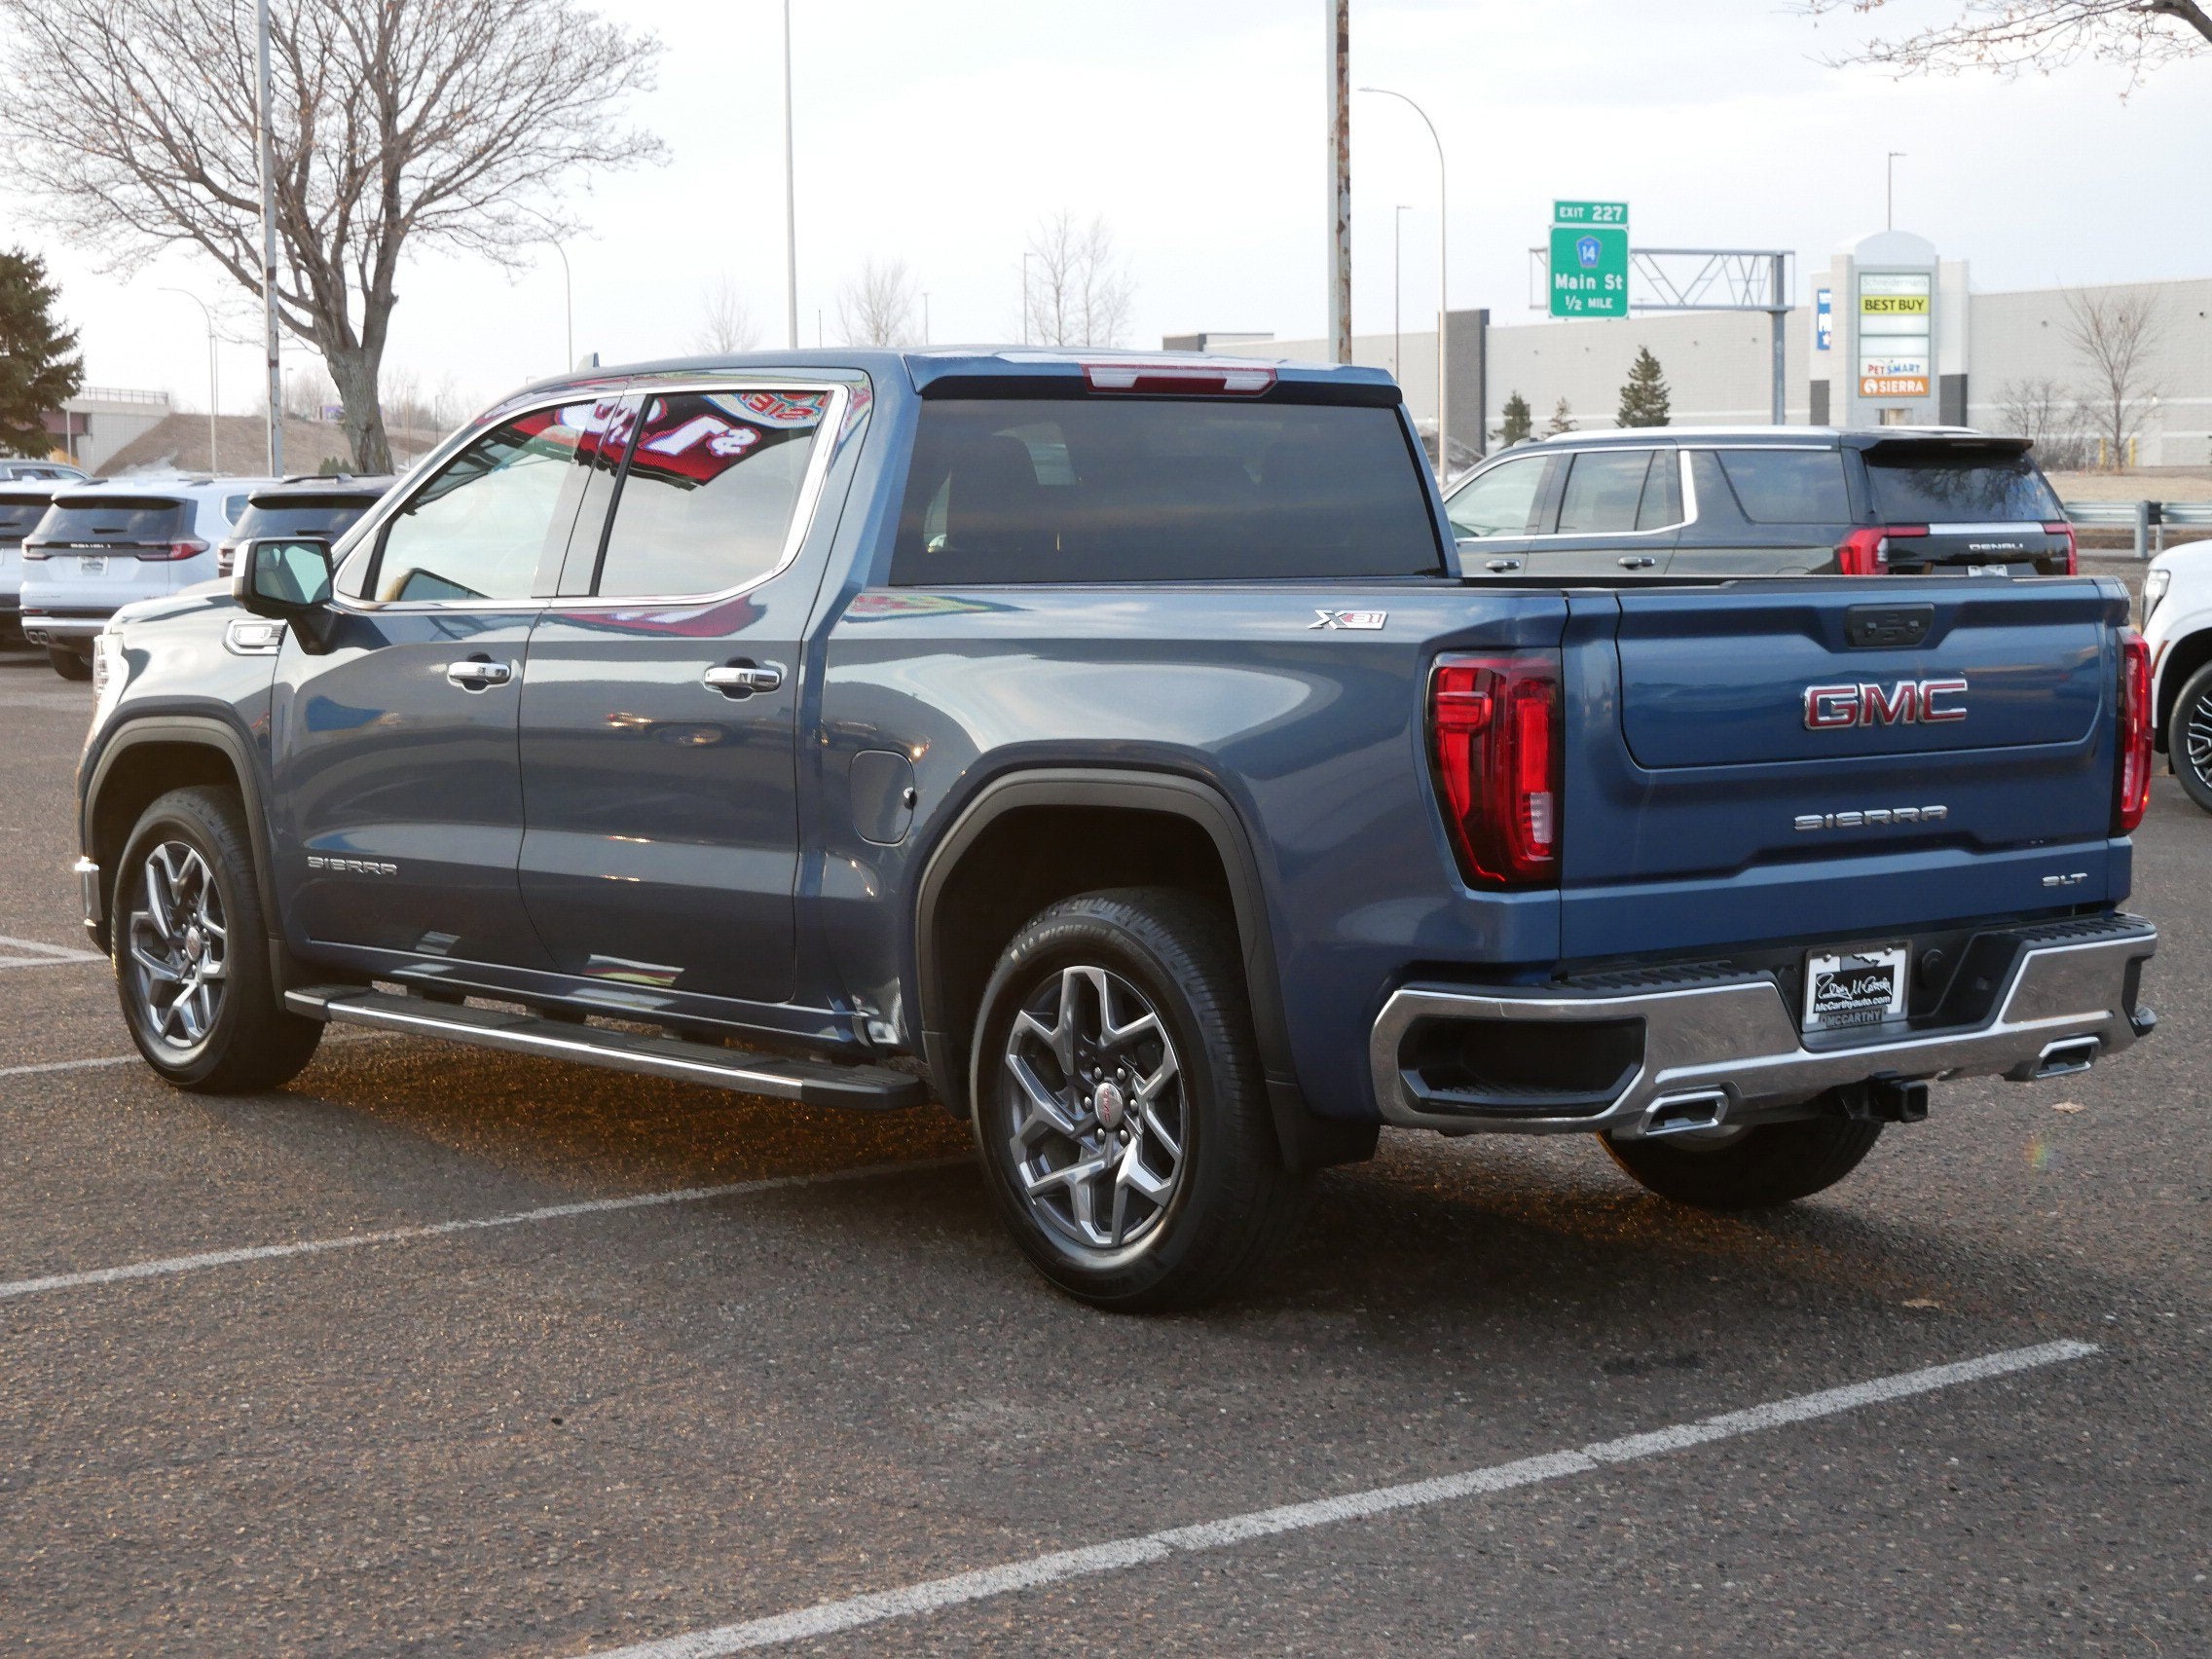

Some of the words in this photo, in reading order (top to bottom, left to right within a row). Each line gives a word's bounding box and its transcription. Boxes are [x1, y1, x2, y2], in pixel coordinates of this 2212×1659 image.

[1559, 206, 1584, 218] EXIT
[1592, 205, 1623, 221] 227
[1582, 245, 1596, 261] 14
[1555, 273, 1596, 290] Main
[1604, 274, 1623, 290] St
[1588, 297, 1613, 309] MILE
[1864, 299, 1896, 311] BEST
[1899, 299, 1924, 311] BUY
[1878, 380, 1925, 392] SIERRA
[1307, 609, 1387, 630] X31
[1802, 679, 1968, 731] GMC
[1793, 805, 1947, 830] SIERRA
[307, 856, 397, 876] SIERRA
[2042, 872, 2087, 887] SLT
